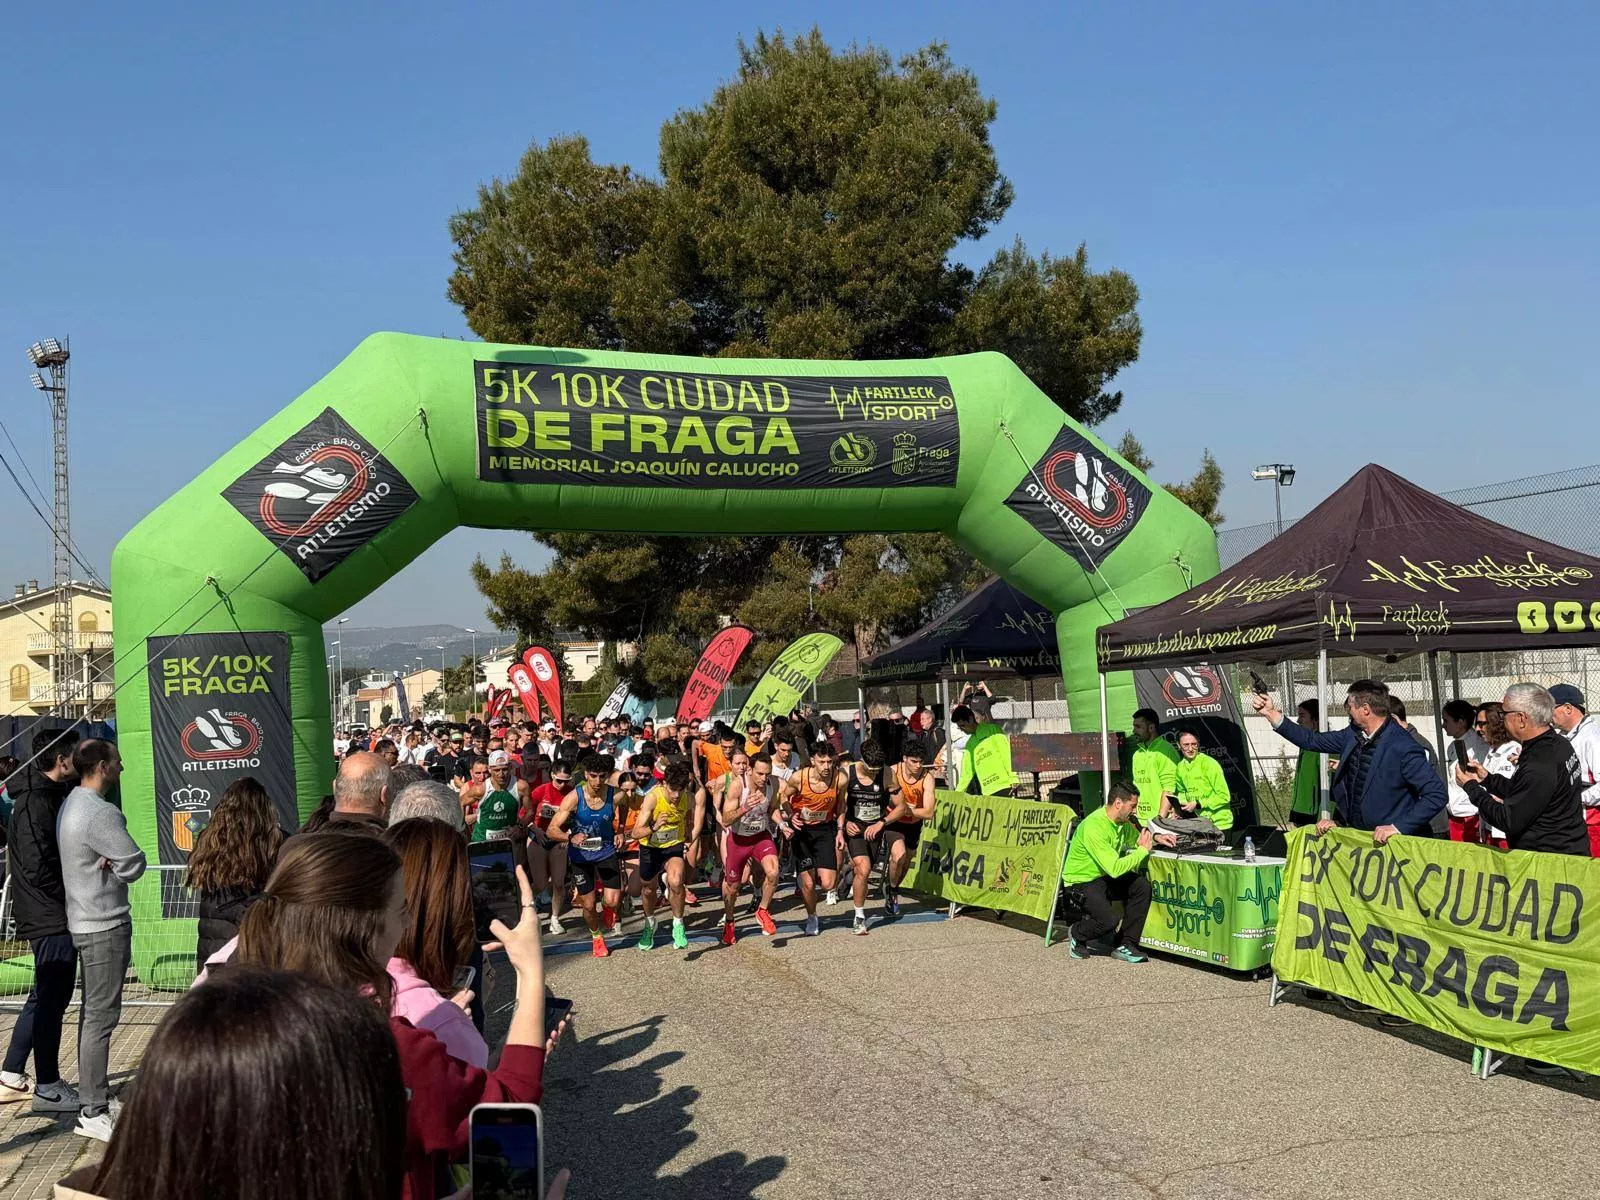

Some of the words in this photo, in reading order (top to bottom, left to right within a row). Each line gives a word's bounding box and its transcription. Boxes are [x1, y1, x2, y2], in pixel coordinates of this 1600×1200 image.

[484, 368, 539, 406] 5K
[550, 372, 629, 408] 10K
[640, 376, 790, 413] CIUDAD
[864, 386, 937, 399] FARTLECK
[871, 405, 940, 421] SPORT
[487, 408, 571, 451] DE
[591, 411, 800, 456] FRAGA
[295, 441, 326, 464] FRAGA
[333, 438, 361, 451] BAJO
[919, 447, 950, 459] Fraga
[489, 456, 605, 474] MEMORIAL
[610, 457, 701, 476] JOAQUÍN
[705, 460, 799, 477] CALUCHO
[296, 482, 391, 560] ATLETISMO
[1025, 483, 1105, 547] ATLETISMO
[1422, 551, 1558, 580] Fartleck
[1380, 600, 1450, 623] Fartleck
[1122, 623, 1278, 658] www.fartlecksport.com
[1405, 619, 1451, 642] Sport
[162, 655, 274, 677] 5K/10K
[696, 656, 730, 684] CAJÓN
[768, 659, 811, 693] CAJÓN
[164, 675, 272, 697] FRAGA
[225, 711, 248, 719] FRAGA
[1166, 703, 1222, 717] ATLETISMO
[182, 757, 261, 772] ATLETISMO
[919, 840, 986, 889] FRAGA
[1151, 863, 1207, 908] artleck
[1300, 832, 1342, 885] 5K
[1349, 847, 1411, 910] 10K
[1414, 863, 1584, 944] CIUDAD
[1166, 900, 1212, 942] Sport
[1139, 936, 1208, 958] artlecksport.com
[1295, 900, 1350, 964] DE
[1360, 923, 1571, 1032] FRAGA
